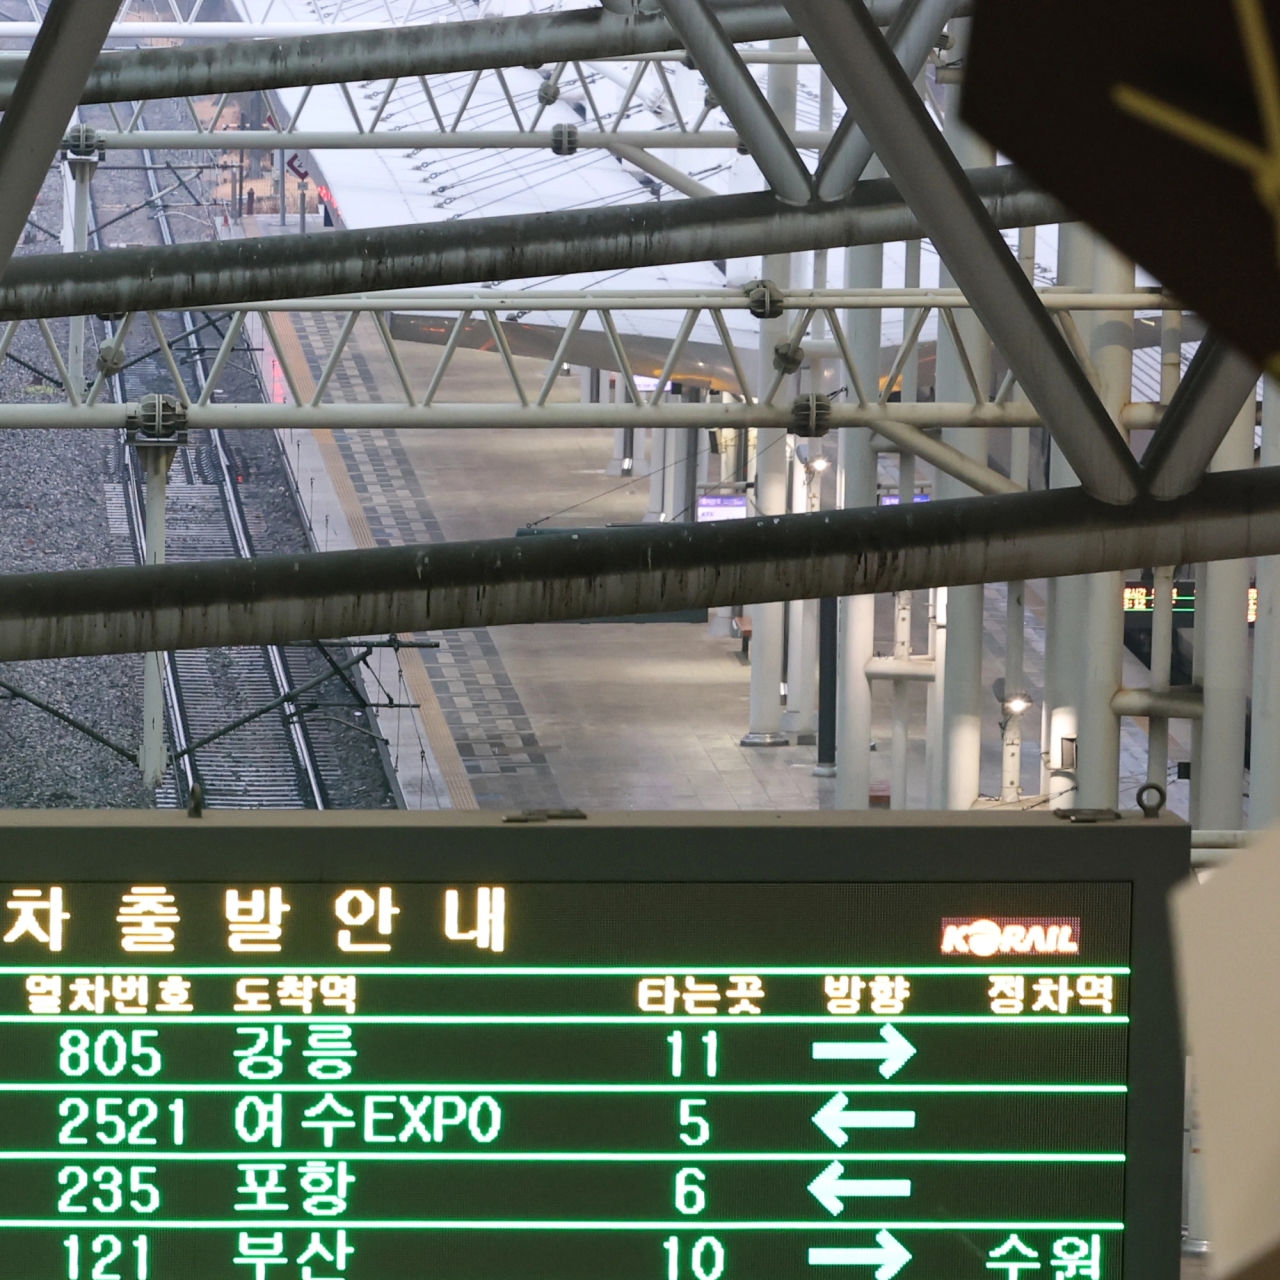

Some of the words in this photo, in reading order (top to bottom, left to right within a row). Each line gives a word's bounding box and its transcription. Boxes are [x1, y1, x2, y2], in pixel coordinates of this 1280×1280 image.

[941, 918, 1078, 956] KORAIL
[26, 974, 195, 1014] 열차번호
[234, 975, 356, 1014] 도착역
[825, 975, 910, 1014] 방향
[988, 975, 1112, 1014] 정차역
[59, 1029, 161, 1077] 805
[233, 1023, 357, 1080] 강릉
[667, 1030, 717, 1077] 11
[59, 1097, 184, 1145] 2521
[235, 1092, 501, 1148] 여수EXPO
[680, 1098, 709, 1146] 5
[58, 1166, 160, 1213] 235
[235, 1161, 356, 1216] 포항
[675, 1167, 705, 1214] 6
[63, 1234, 148, 1280] 121
